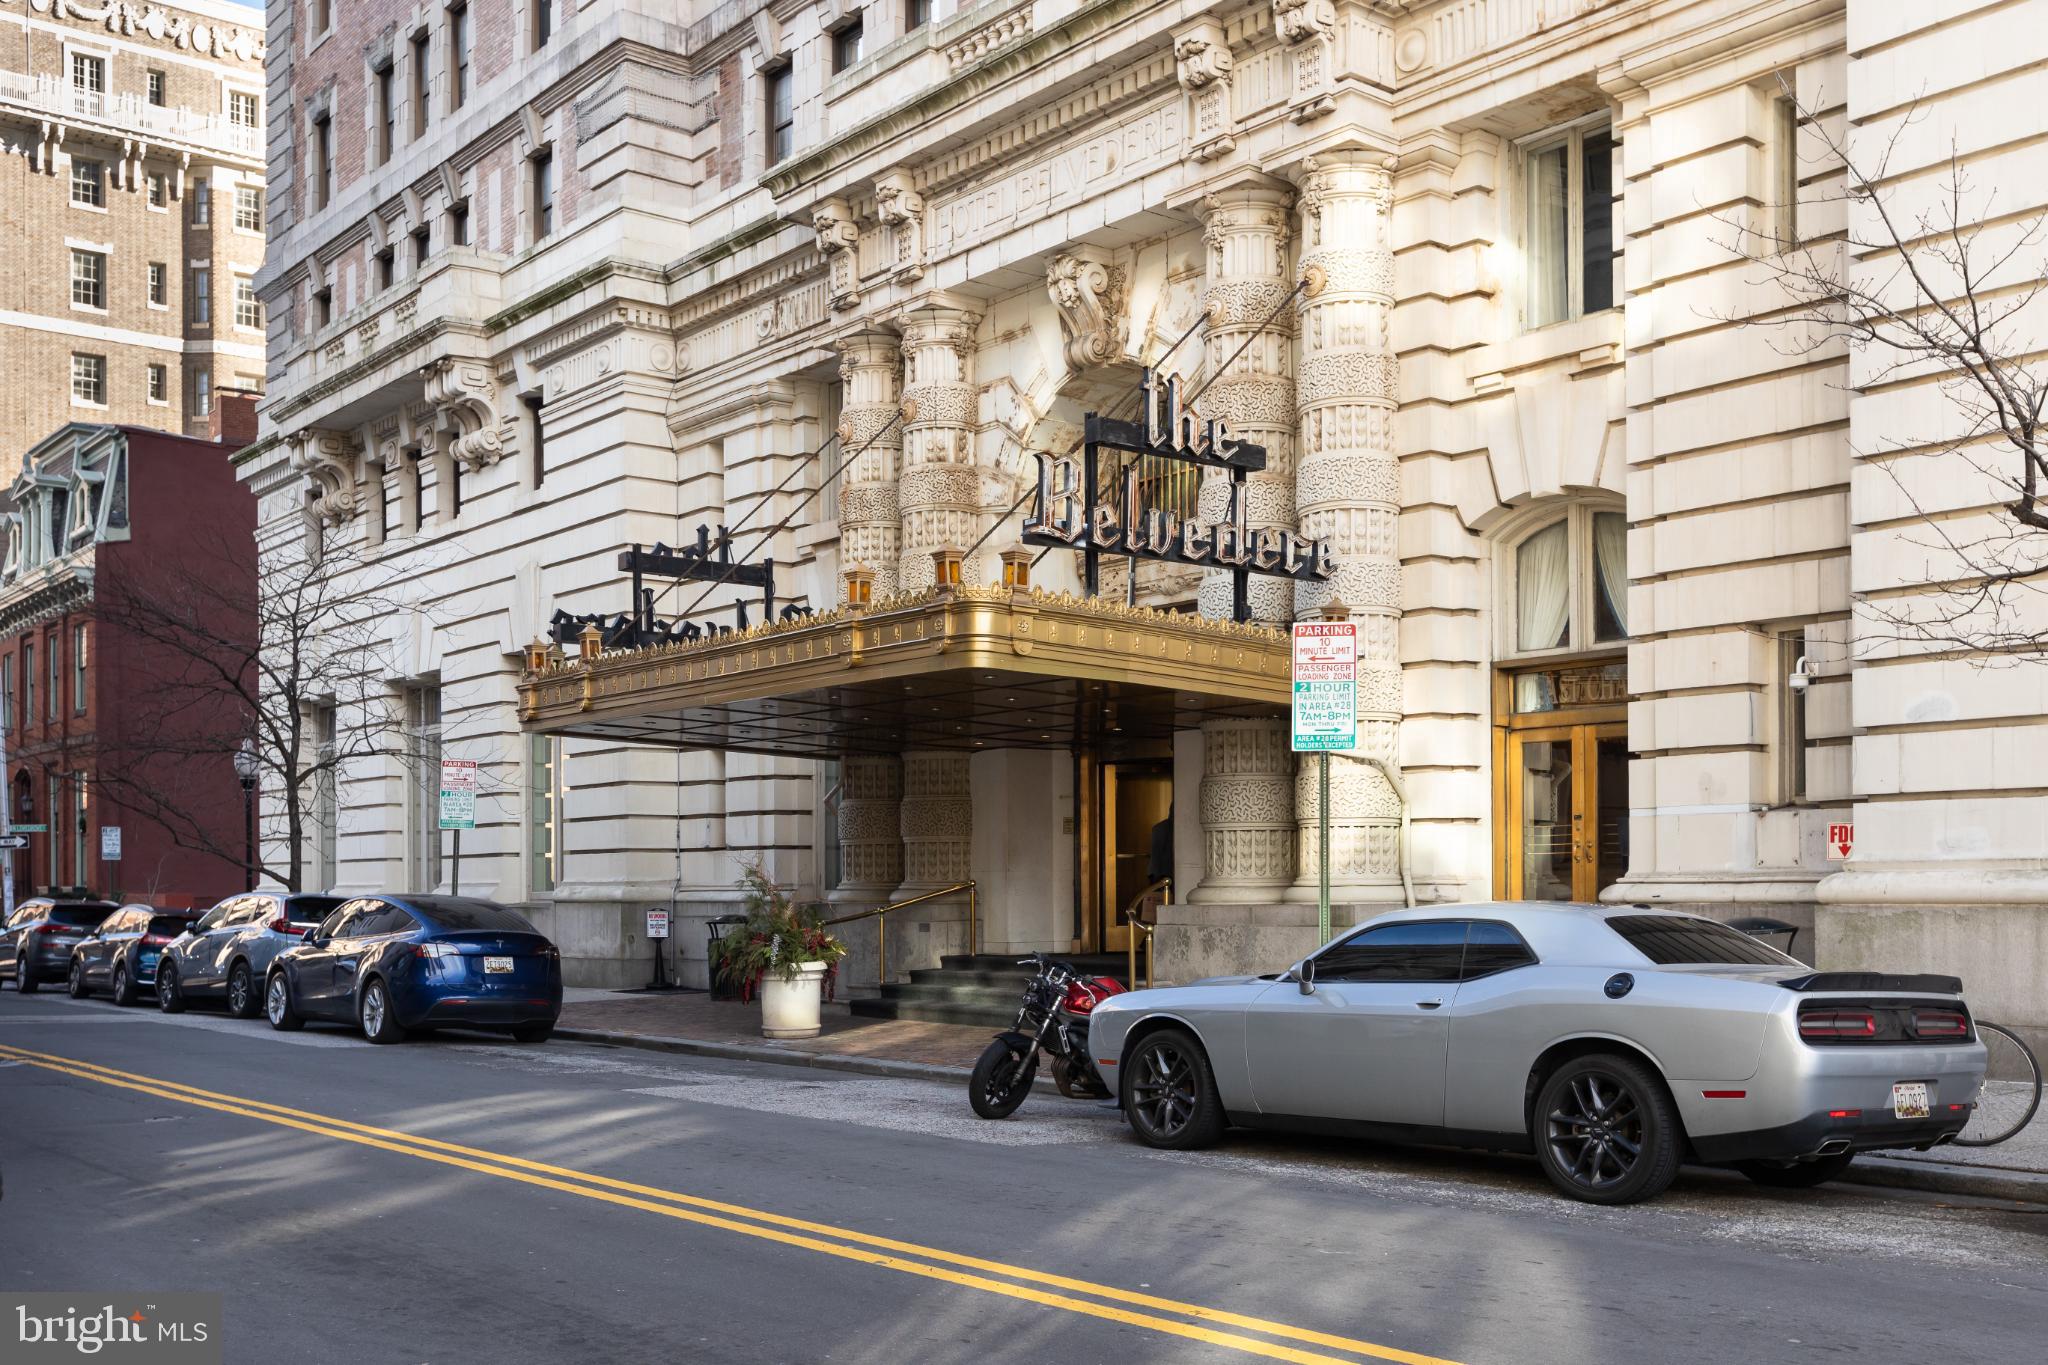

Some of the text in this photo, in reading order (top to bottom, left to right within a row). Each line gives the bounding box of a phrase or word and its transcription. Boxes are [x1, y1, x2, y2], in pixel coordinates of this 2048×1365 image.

[937, 108, 1179, 247] HOTEL BELVEDERE
[1022, 451, 1338, 579] Belvedere
[1298, 625, 1352, 636] PARKING
[1319, 637, 1331, 646] 10
[1299, 646, 1351, 656] MINUTE LIMIT
[1298, 664, 1351, 672] PASSENGER
[1298, 672, 1352, 681] LOADING ZONE
[1300, 682, 1351, 692] 2 HOUR
[1298, 692, 1351, 701] PARKING LIMIT
[1298, 702, 1307, 711] IN
[1308, 701, 1333, 711] AREA
[1299, 711, 1351, 721] 7AM-8PM
